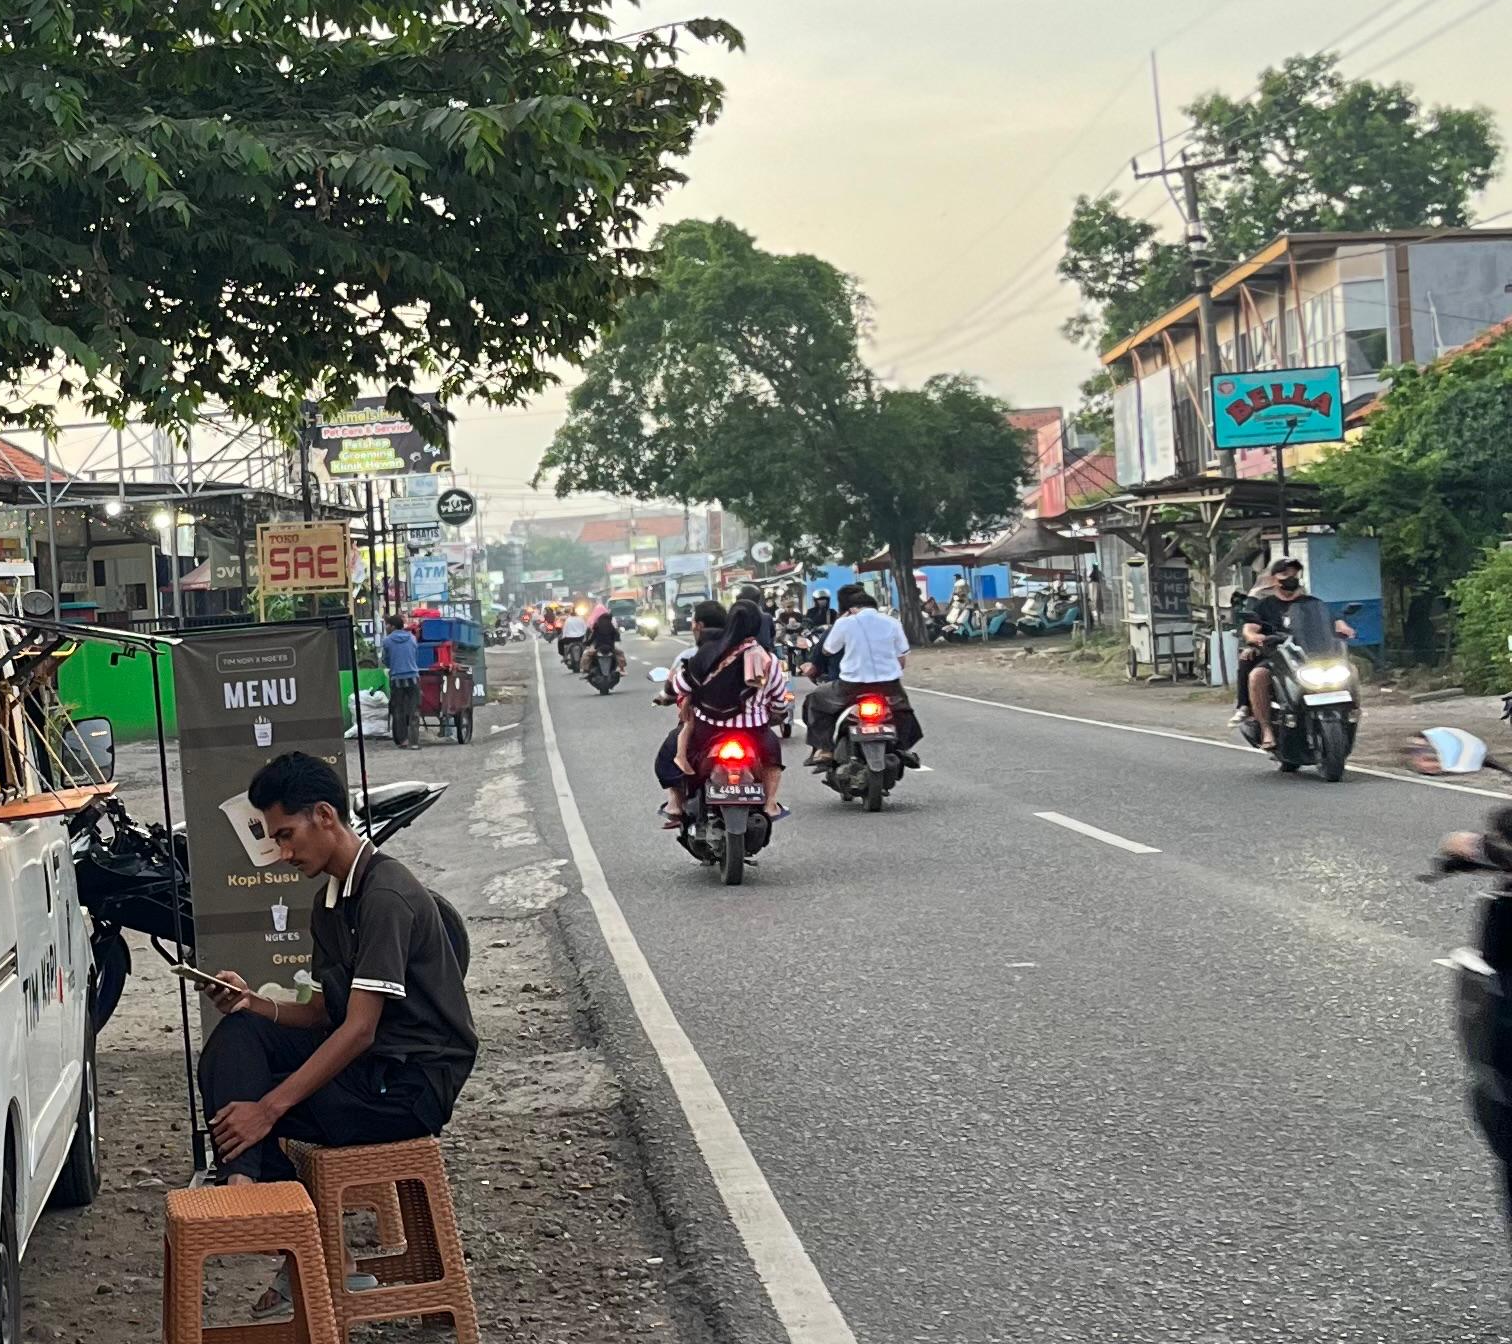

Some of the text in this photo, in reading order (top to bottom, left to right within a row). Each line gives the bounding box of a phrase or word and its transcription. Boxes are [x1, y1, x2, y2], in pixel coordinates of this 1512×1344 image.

[1225, 383, 1332, 426] BELLA
[375, 422, 412, 434] Service
[268, 534, 300, 544] TOKO
[269, 545, 338, 581] SAE
[414, 566, 445, 579] ATM
[223, 677, 296, 709] MENU
[227, 871, 299, 887] Kopi Susu
